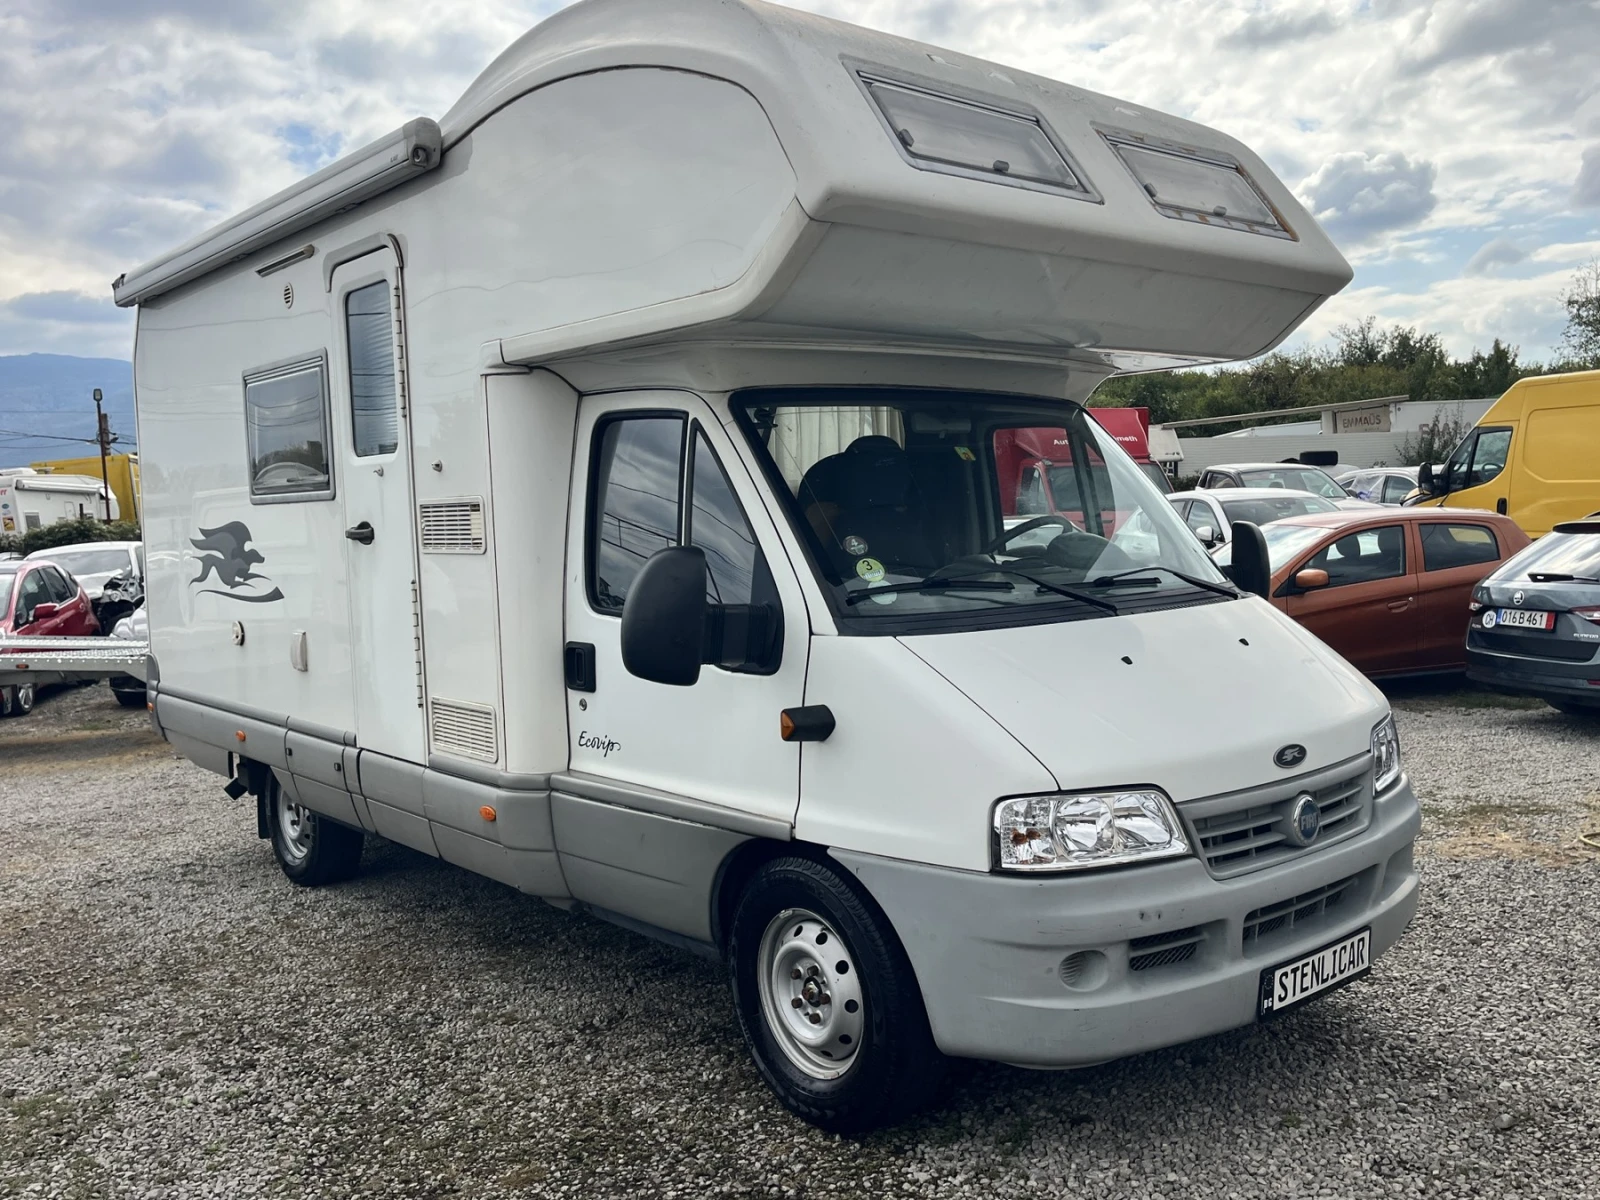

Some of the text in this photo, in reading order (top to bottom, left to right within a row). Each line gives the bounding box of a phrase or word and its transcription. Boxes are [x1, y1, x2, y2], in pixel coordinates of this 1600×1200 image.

[862, 560, 873, 571] 3
[578, 730, 622, 758] Ecovip
[1278, 936, 1365, 1003] STENLICAR
